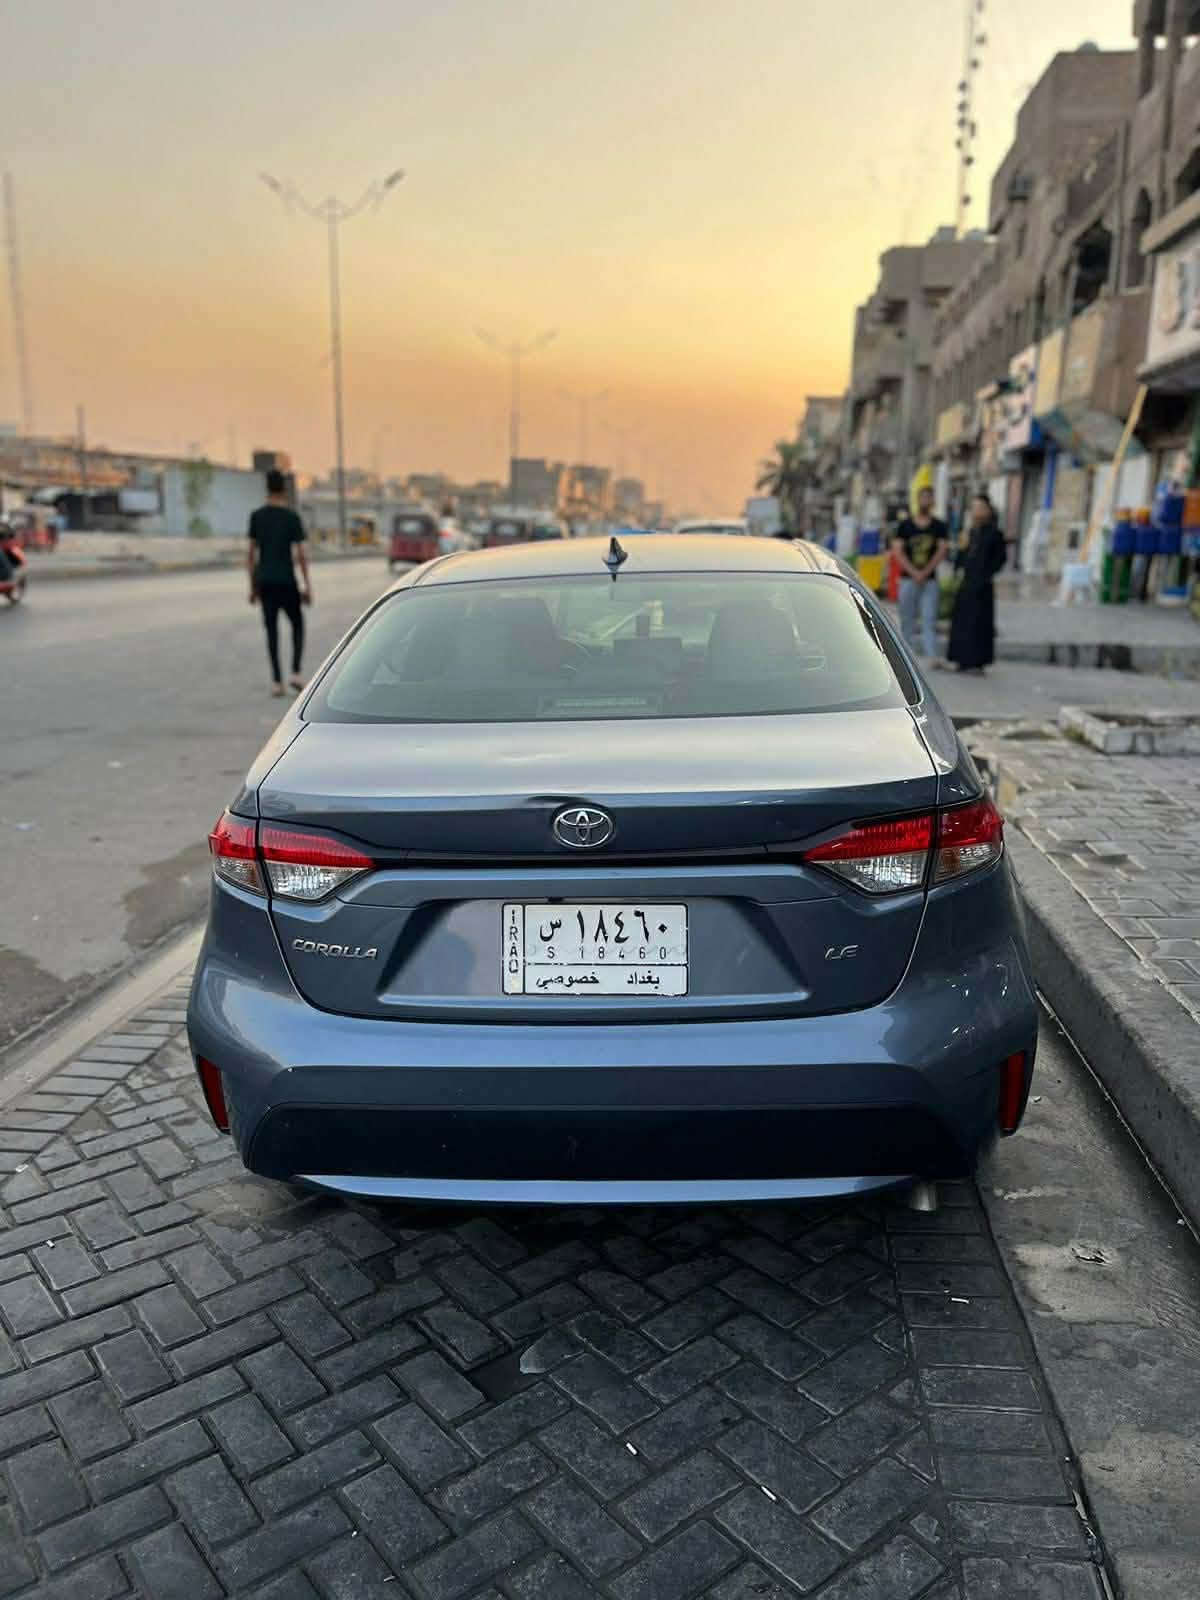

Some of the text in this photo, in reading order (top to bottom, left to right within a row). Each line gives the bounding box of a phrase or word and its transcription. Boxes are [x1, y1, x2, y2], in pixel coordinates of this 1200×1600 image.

[539, 909, 668, 944] س ١٨٤٦٠
[292, 938, 378, 960] COROLLA
[508, 909, 520, 974] IRAQ
[546, 946, 556, 960] S
[824, 944, 859, 961] LE
[535, 969, 661, 990] بغداد خصوصي
